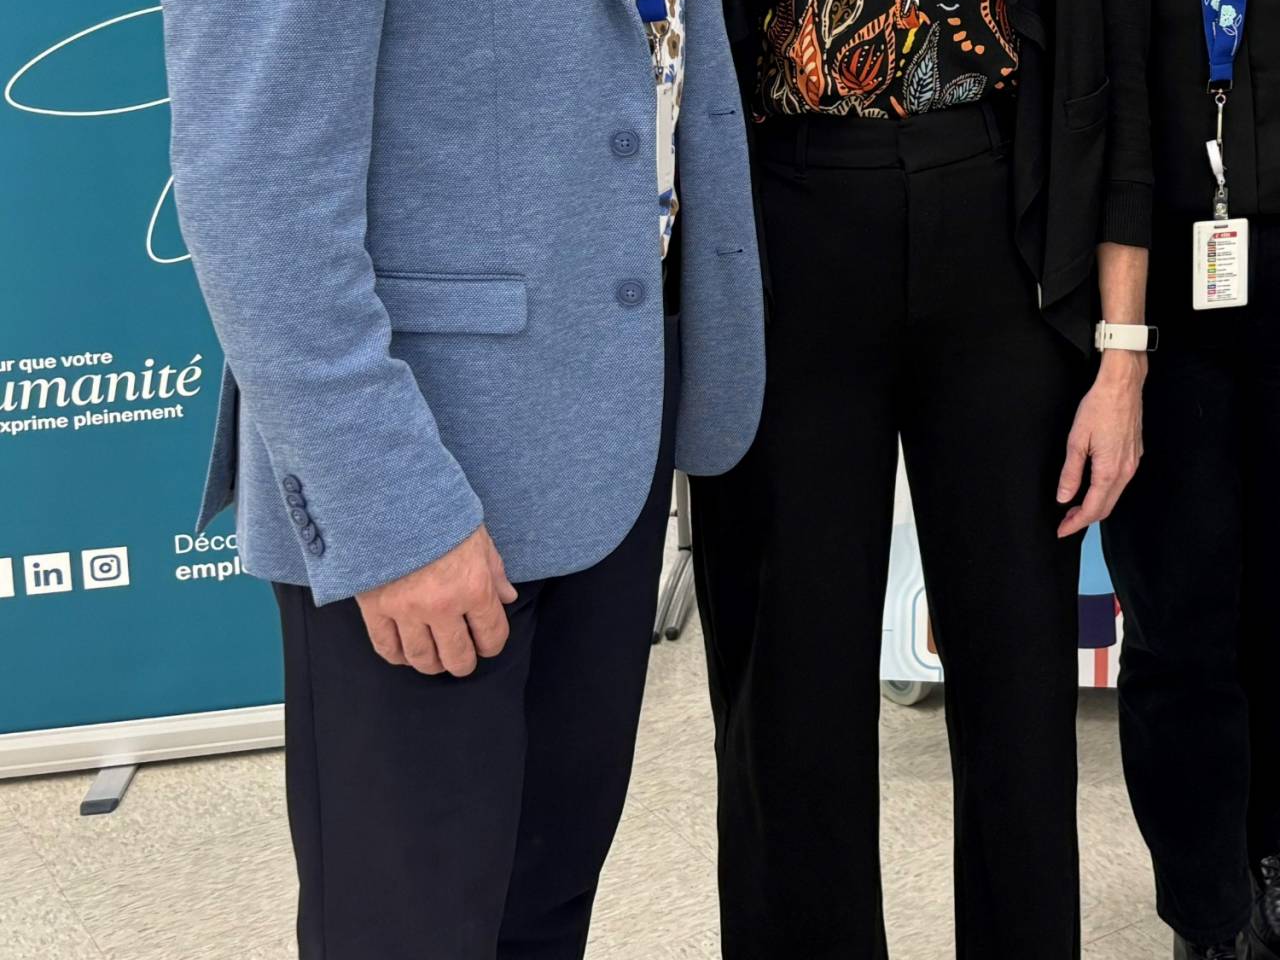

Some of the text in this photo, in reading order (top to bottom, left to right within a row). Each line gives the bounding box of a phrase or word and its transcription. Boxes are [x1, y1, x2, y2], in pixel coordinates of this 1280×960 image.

[19, 357, 57, 373] que
[61, 352, 113, 367] votre
[0, 404, 184, 435] xprime pleinement
